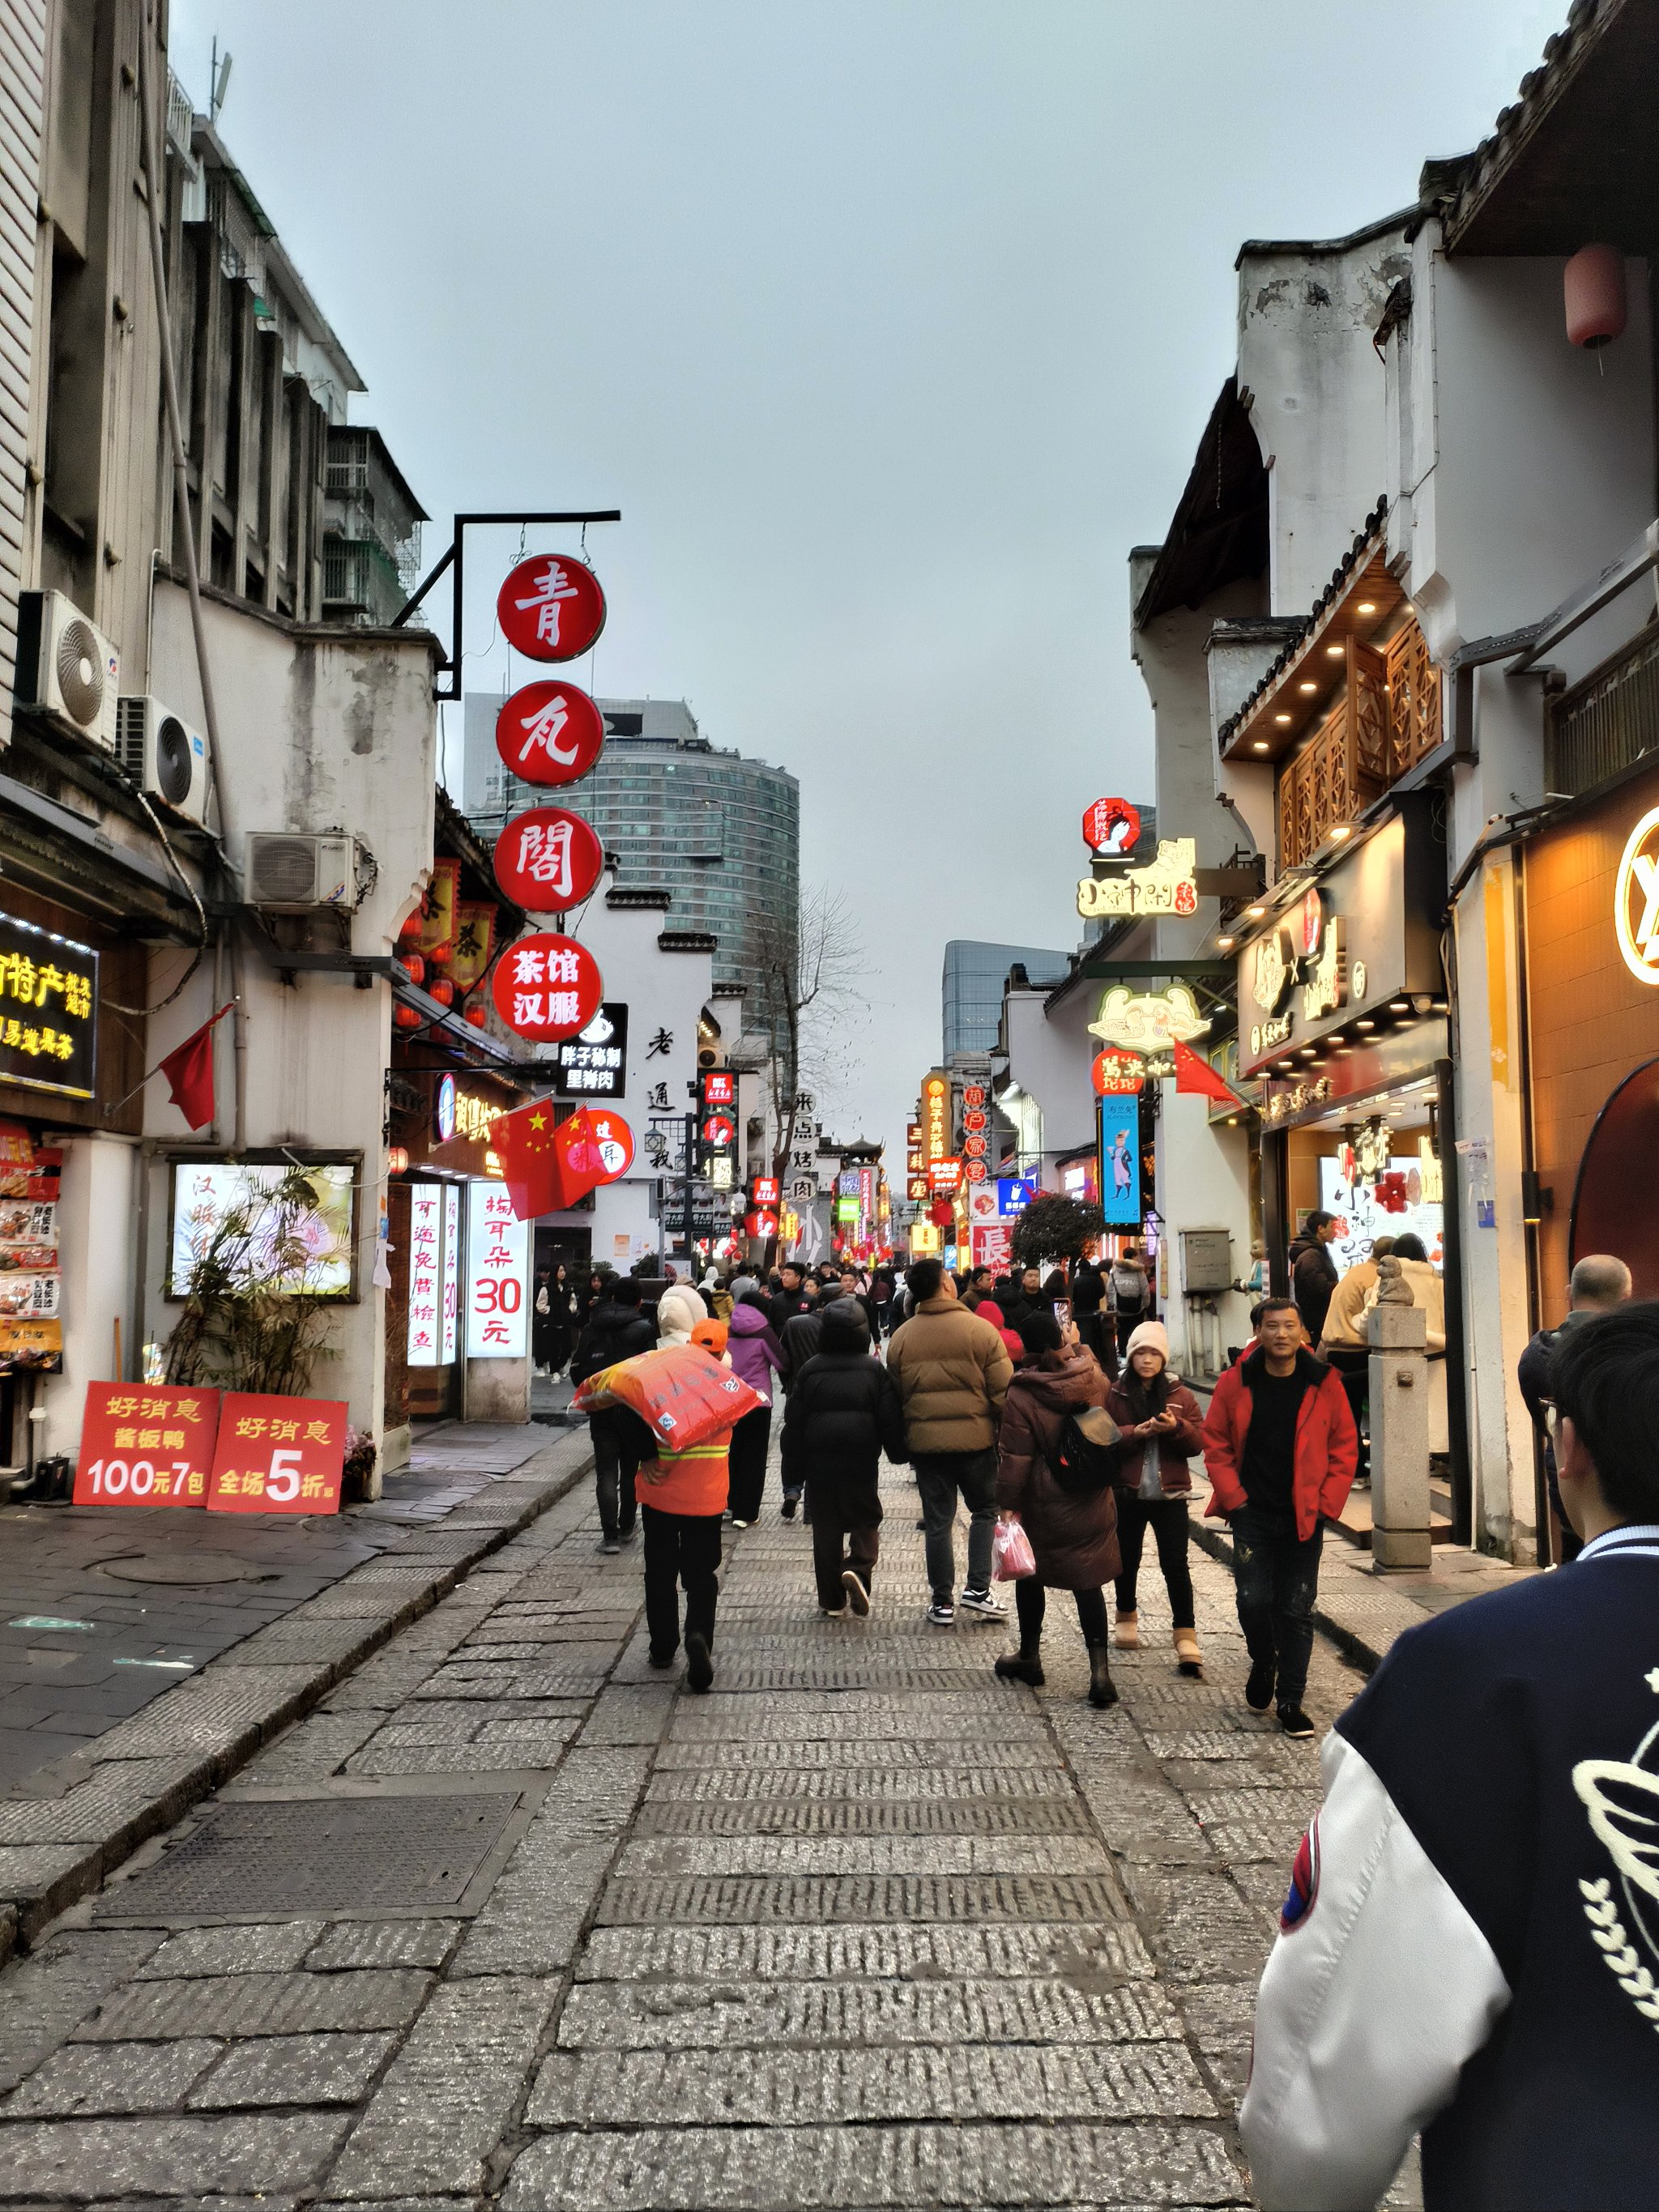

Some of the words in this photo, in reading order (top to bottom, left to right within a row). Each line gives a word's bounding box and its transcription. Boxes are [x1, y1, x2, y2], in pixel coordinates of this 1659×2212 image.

[0, 952, 66, 1008] 特产
[512, 948, 580, 984] 茶馆
[513, 991, 581, 1025] 汉服
[561, 1046, 621, 1068] 胖子秘制
[566, 1069, 615, 1089] 里脊肉
[792, 1093, 813, 1199] 来点烤肉
[106, 1396, 203, 1423] 好消息
[114, 1427, 185, 1450] 酱板鸭
[235, 1417, 332, 1445] 好消息
[87, 1459, 204, 1495] 100元7包
